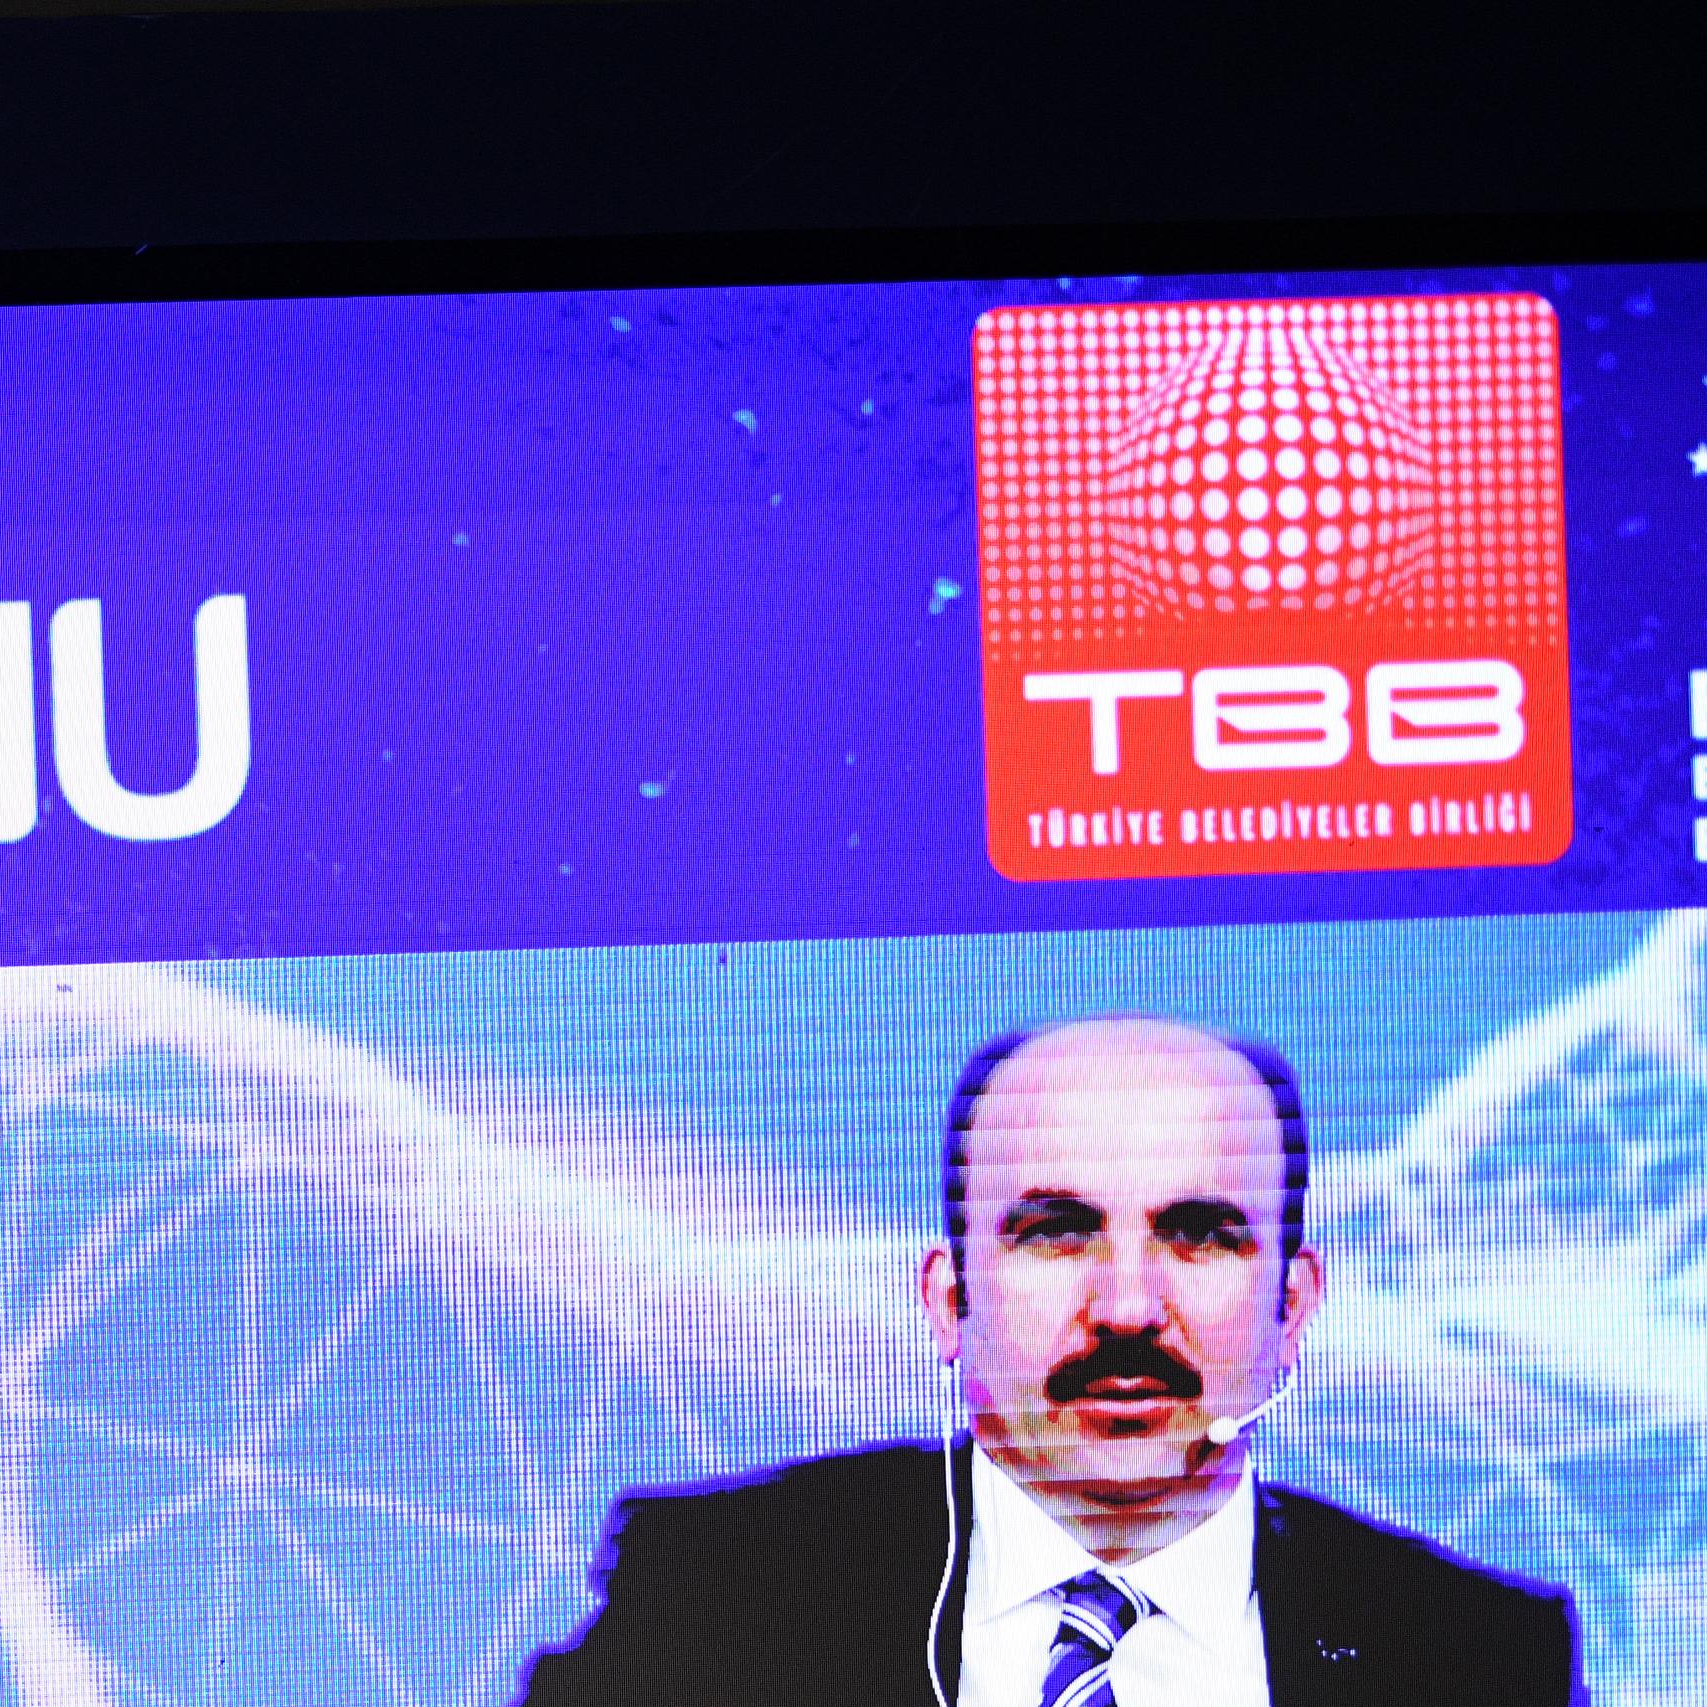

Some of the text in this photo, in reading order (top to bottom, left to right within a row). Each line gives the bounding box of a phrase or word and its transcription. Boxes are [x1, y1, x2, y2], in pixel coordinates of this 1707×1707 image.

[1023, 658, 1525, 775] TBB
[1028, 792, 1532, 848] TÜRKİYE BELEDİYELER BİRLİĞİ
